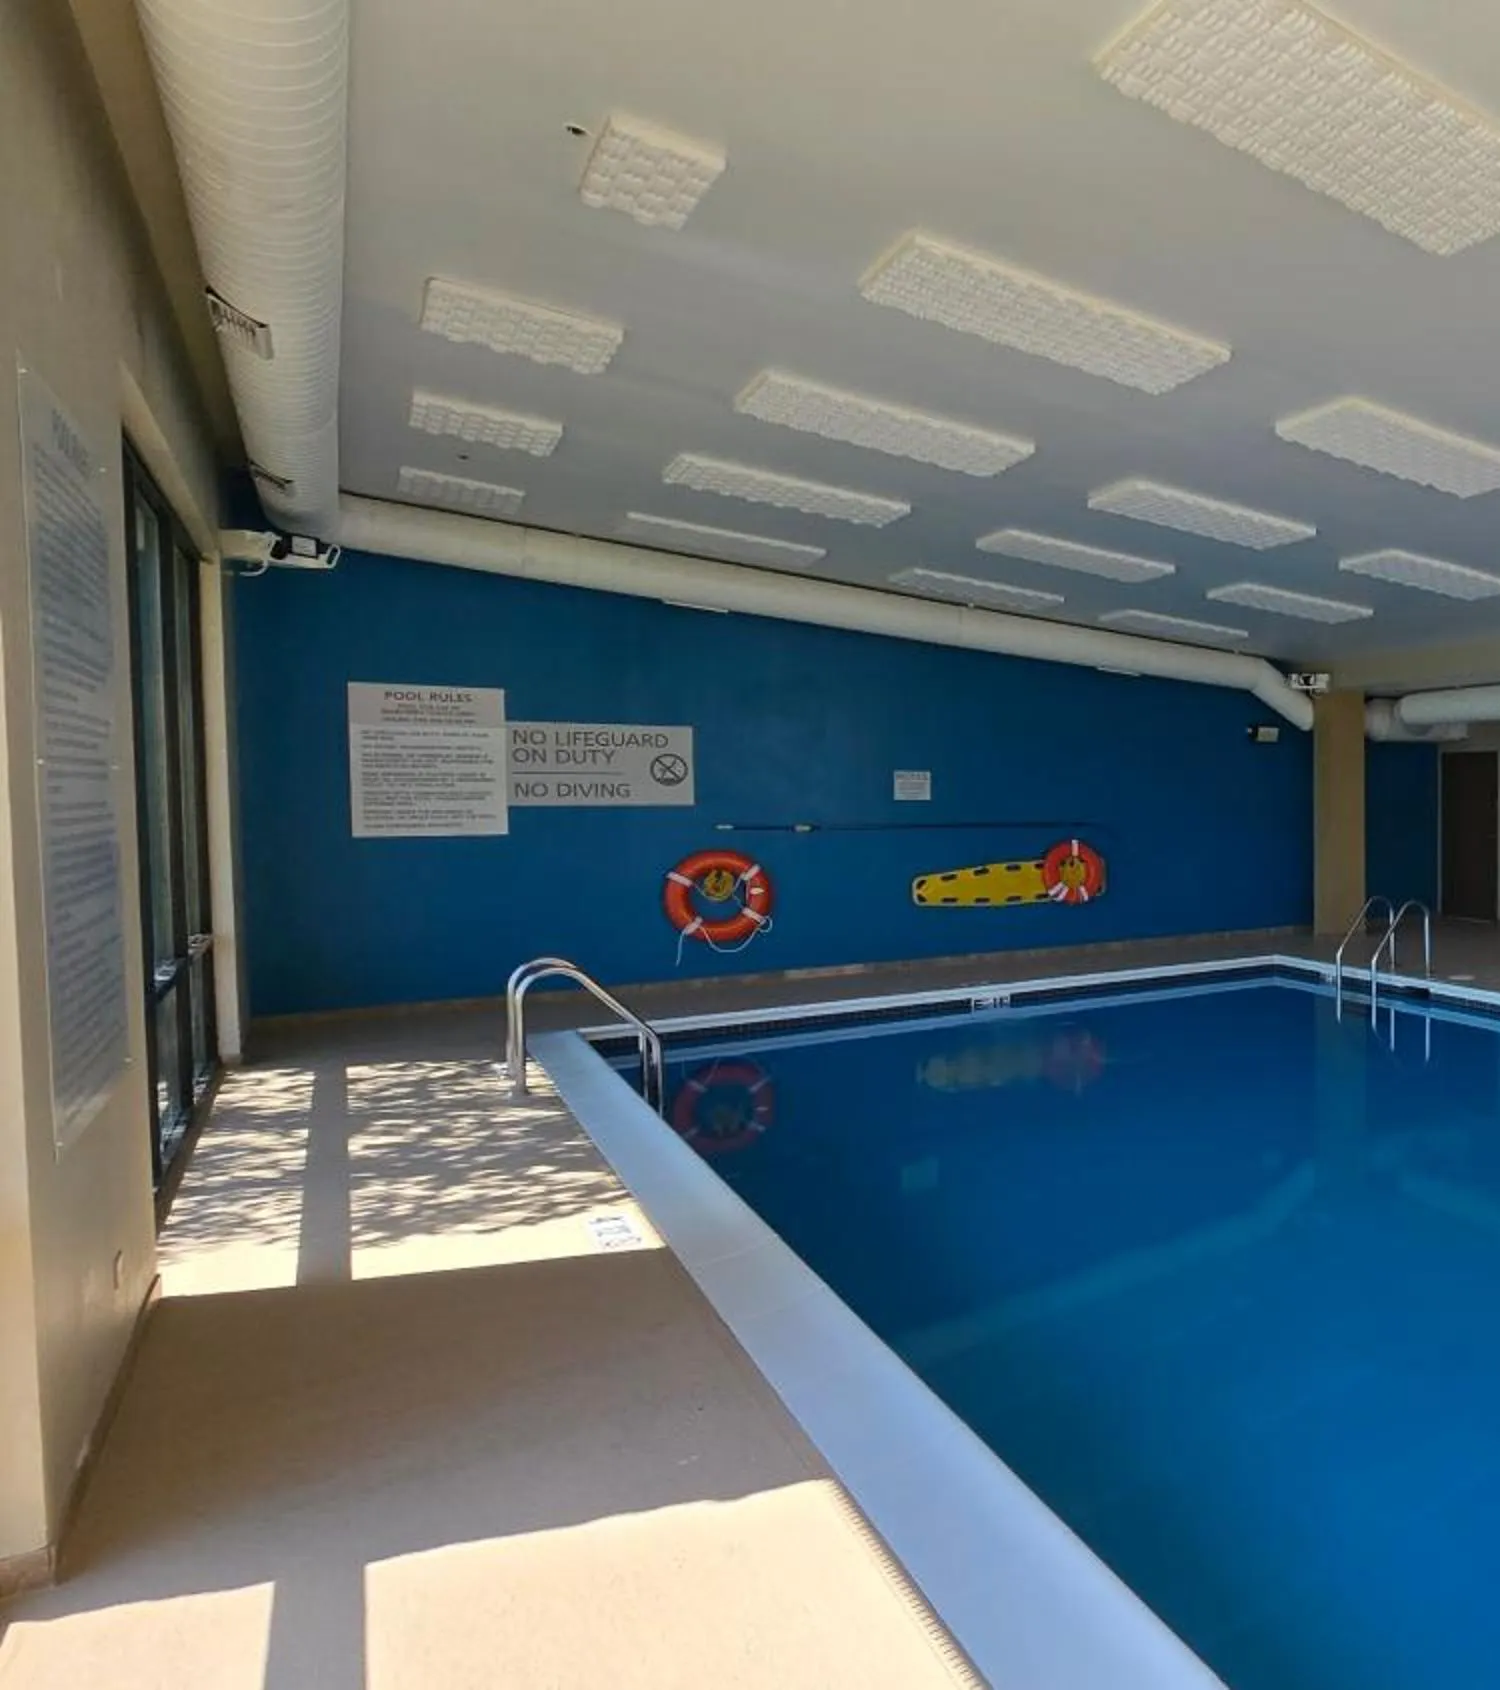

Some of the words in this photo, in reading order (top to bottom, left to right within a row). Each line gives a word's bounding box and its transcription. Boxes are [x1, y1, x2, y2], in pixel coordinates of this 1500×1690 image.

[384, 691, 422, 701] POOL
[430, 691, 473, 703] RULES
[512, 729, 547, 745] NO
[555, 731, 669, 748] LIFEGUARD
[512, 748, 547, 763] ON
[556, 750, 616, 764] DUTY
[514, 783, 549, 798] NO
[557, 783, 631, 798] DIVING
